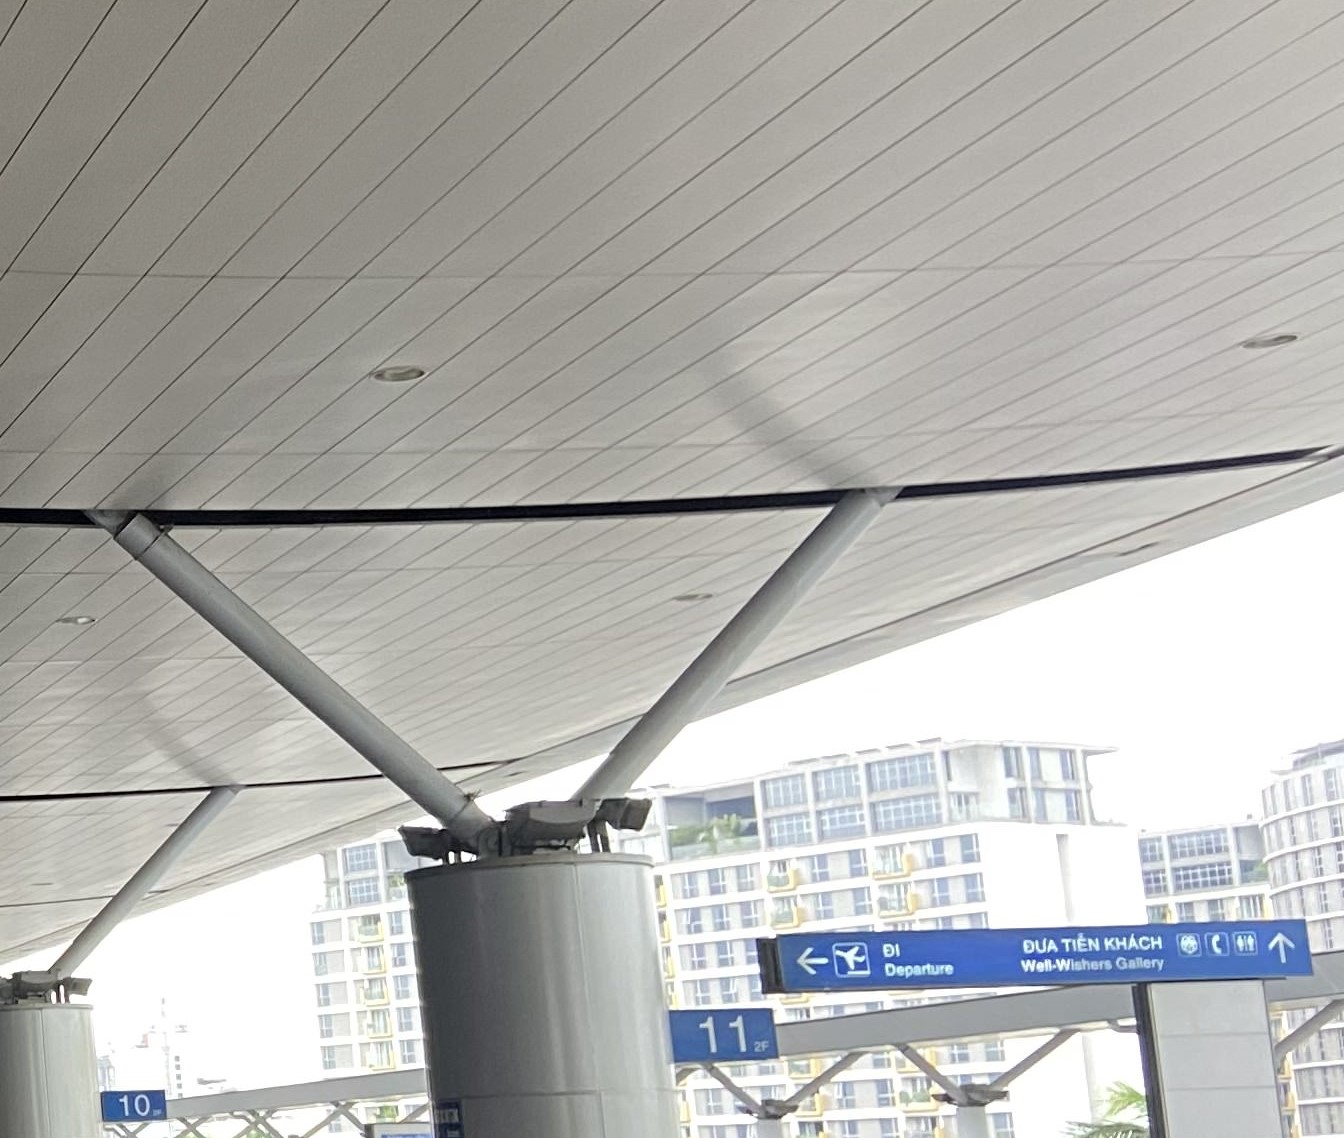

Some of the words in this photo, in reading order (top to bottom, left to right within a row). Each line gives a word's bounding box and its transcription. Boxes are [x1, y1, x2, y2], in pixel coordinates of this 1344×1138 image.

[883, 943, 900, 958] ĐI
[1023, 938, 1058, 954] ĐƯA
[1104, 933, 1163, 951] KHÁCH
[885, 963, 954, 979] Departure
[1021, 958, 1113, 973] Well-Wishers
[1115, 957, 1164, 971] Gallery
[698, 1015, 747, 1053] 11
[754, 1041, 769, 1052] 2F
[119, 1094, 150, 1116] 10
